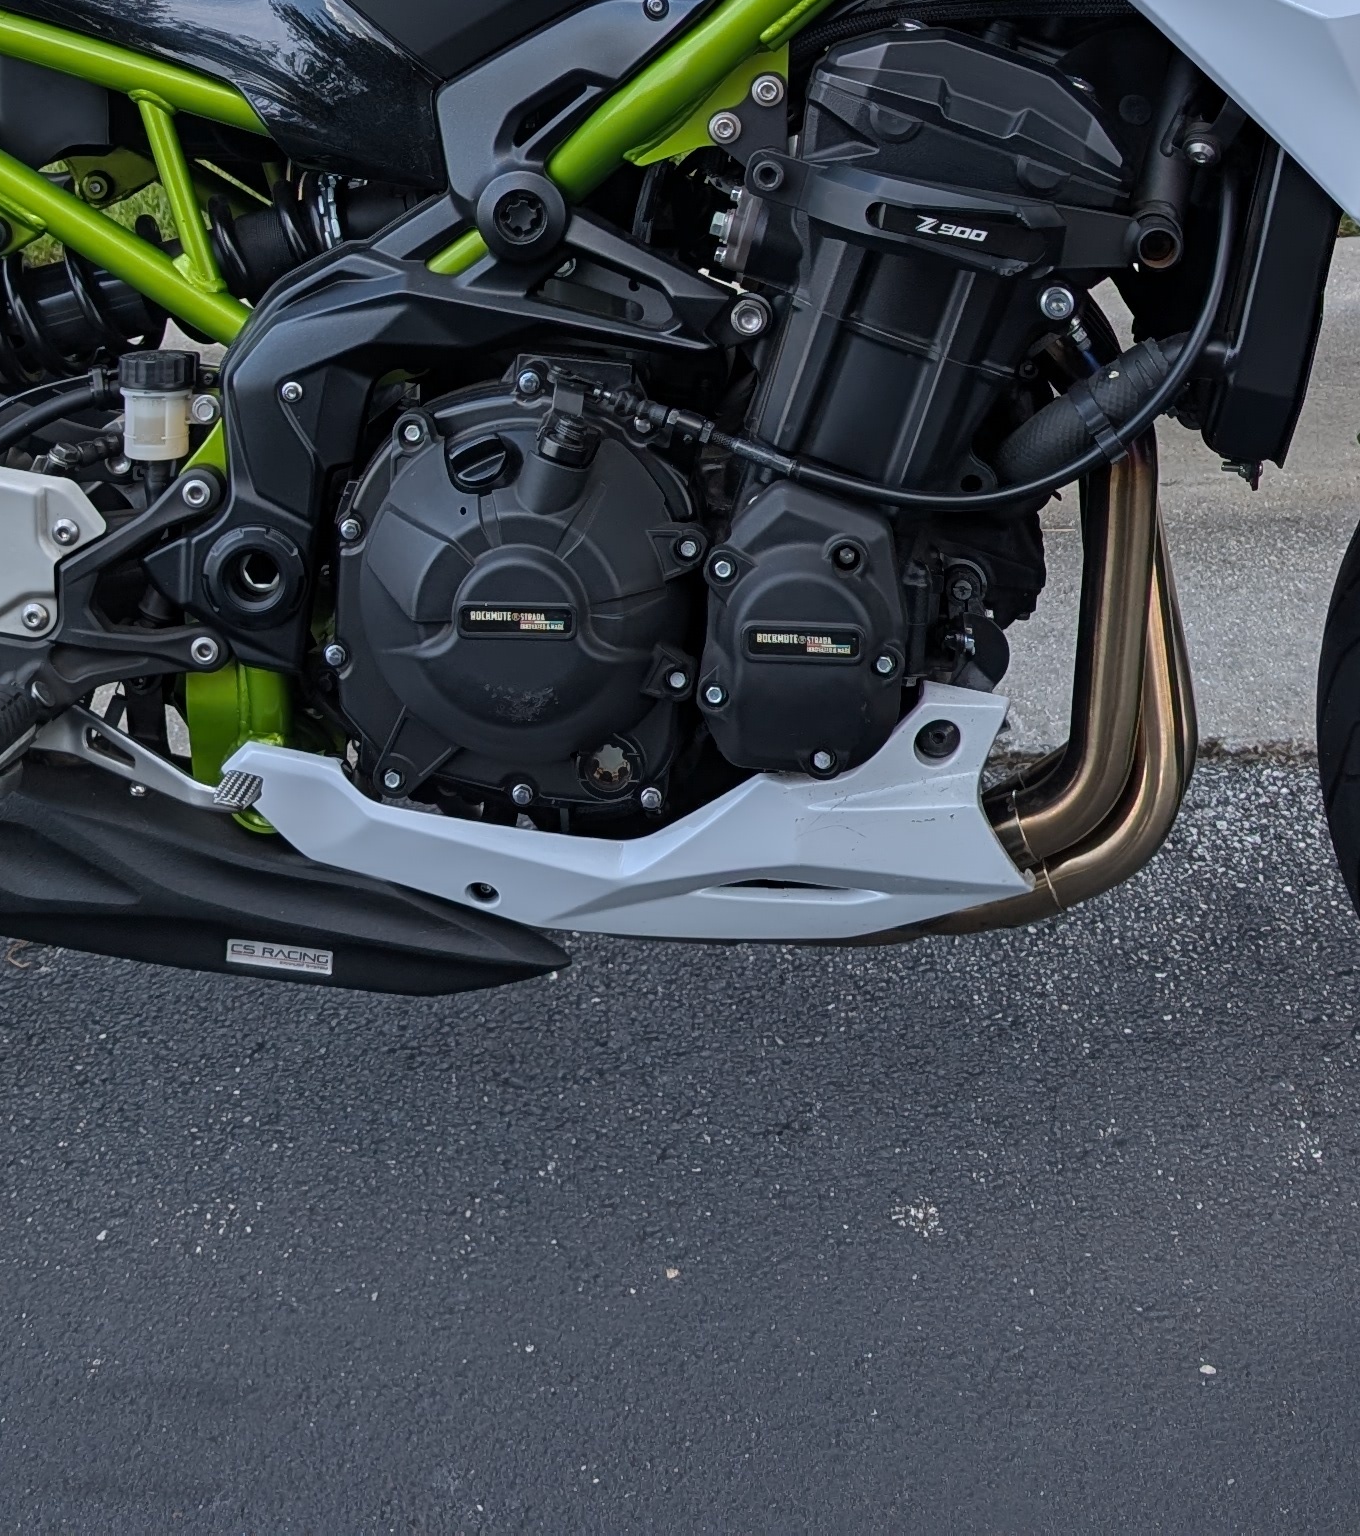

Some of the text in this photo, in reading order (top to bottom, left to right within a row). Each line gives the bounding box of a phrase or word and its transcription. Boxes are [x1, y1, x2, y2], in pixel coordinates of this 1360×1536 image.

[916, 214, 988, 243] Z900
[231, 944, 329, 964] CS RACING
